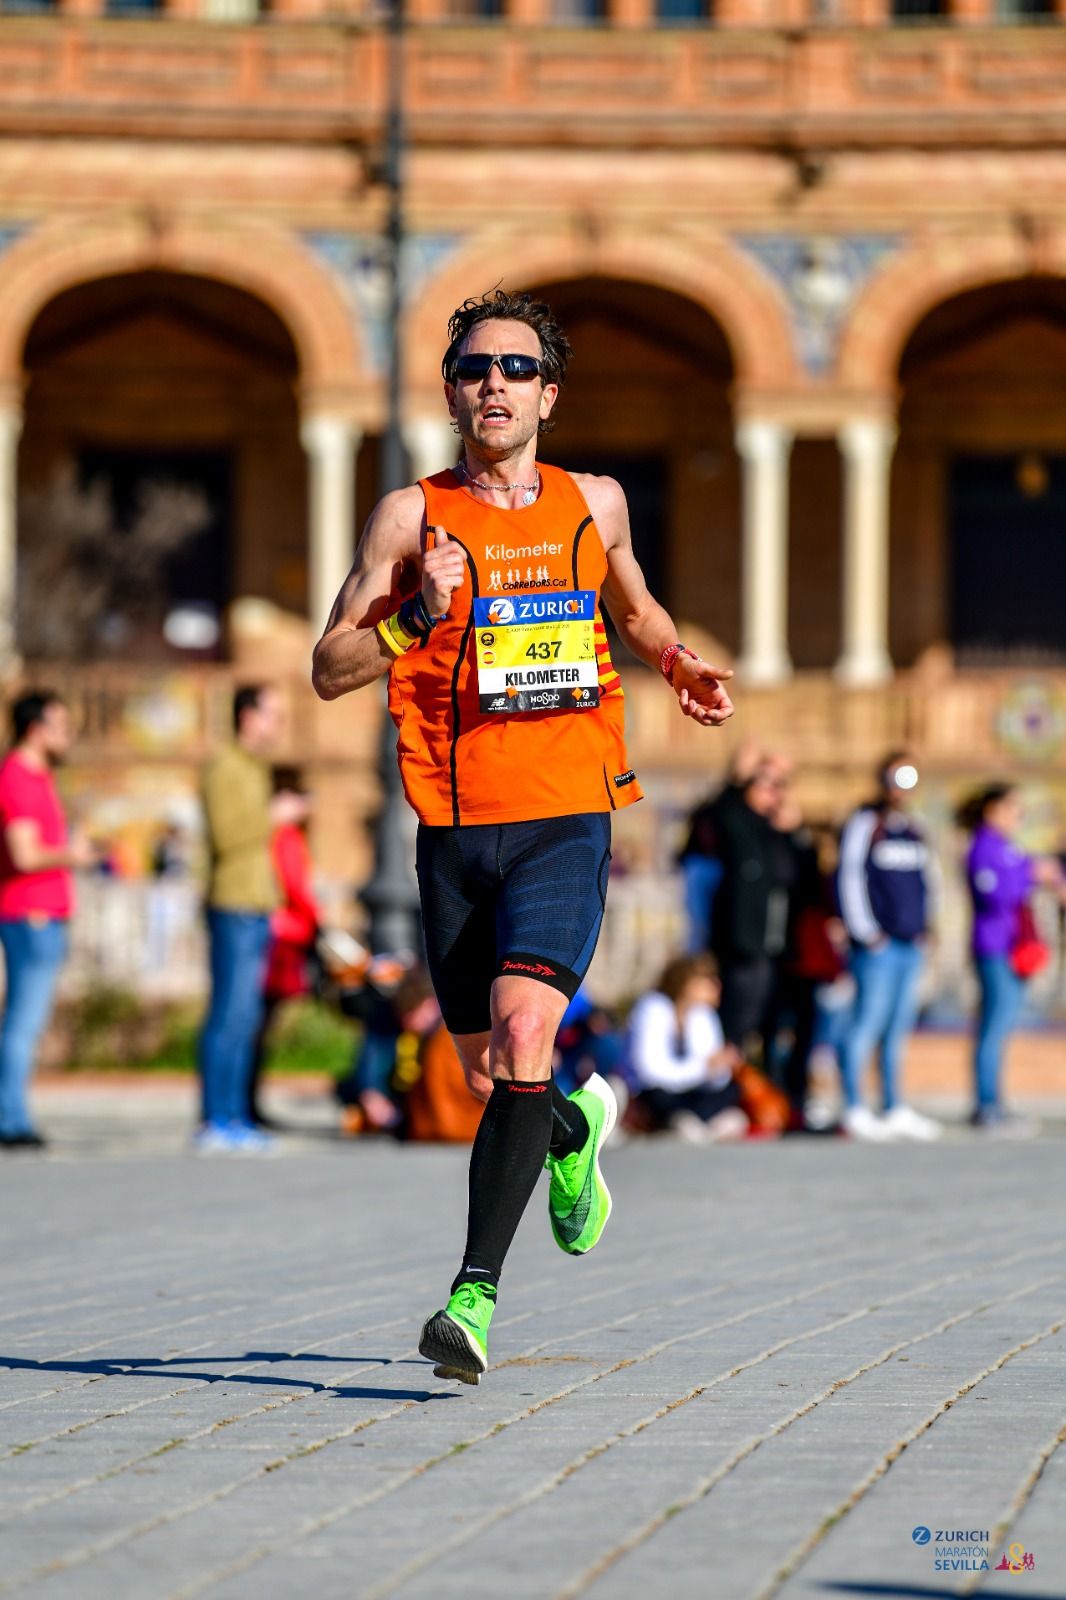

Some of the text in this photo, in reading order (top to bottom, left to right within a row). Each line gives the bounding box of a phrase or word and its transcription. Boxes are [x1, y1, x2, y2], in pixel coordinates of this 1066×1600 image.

[485, 541, 563, 561] Kilometer
[525, 641, 562, 660] 437
[505, 668, 580, 687] KILOMETER
